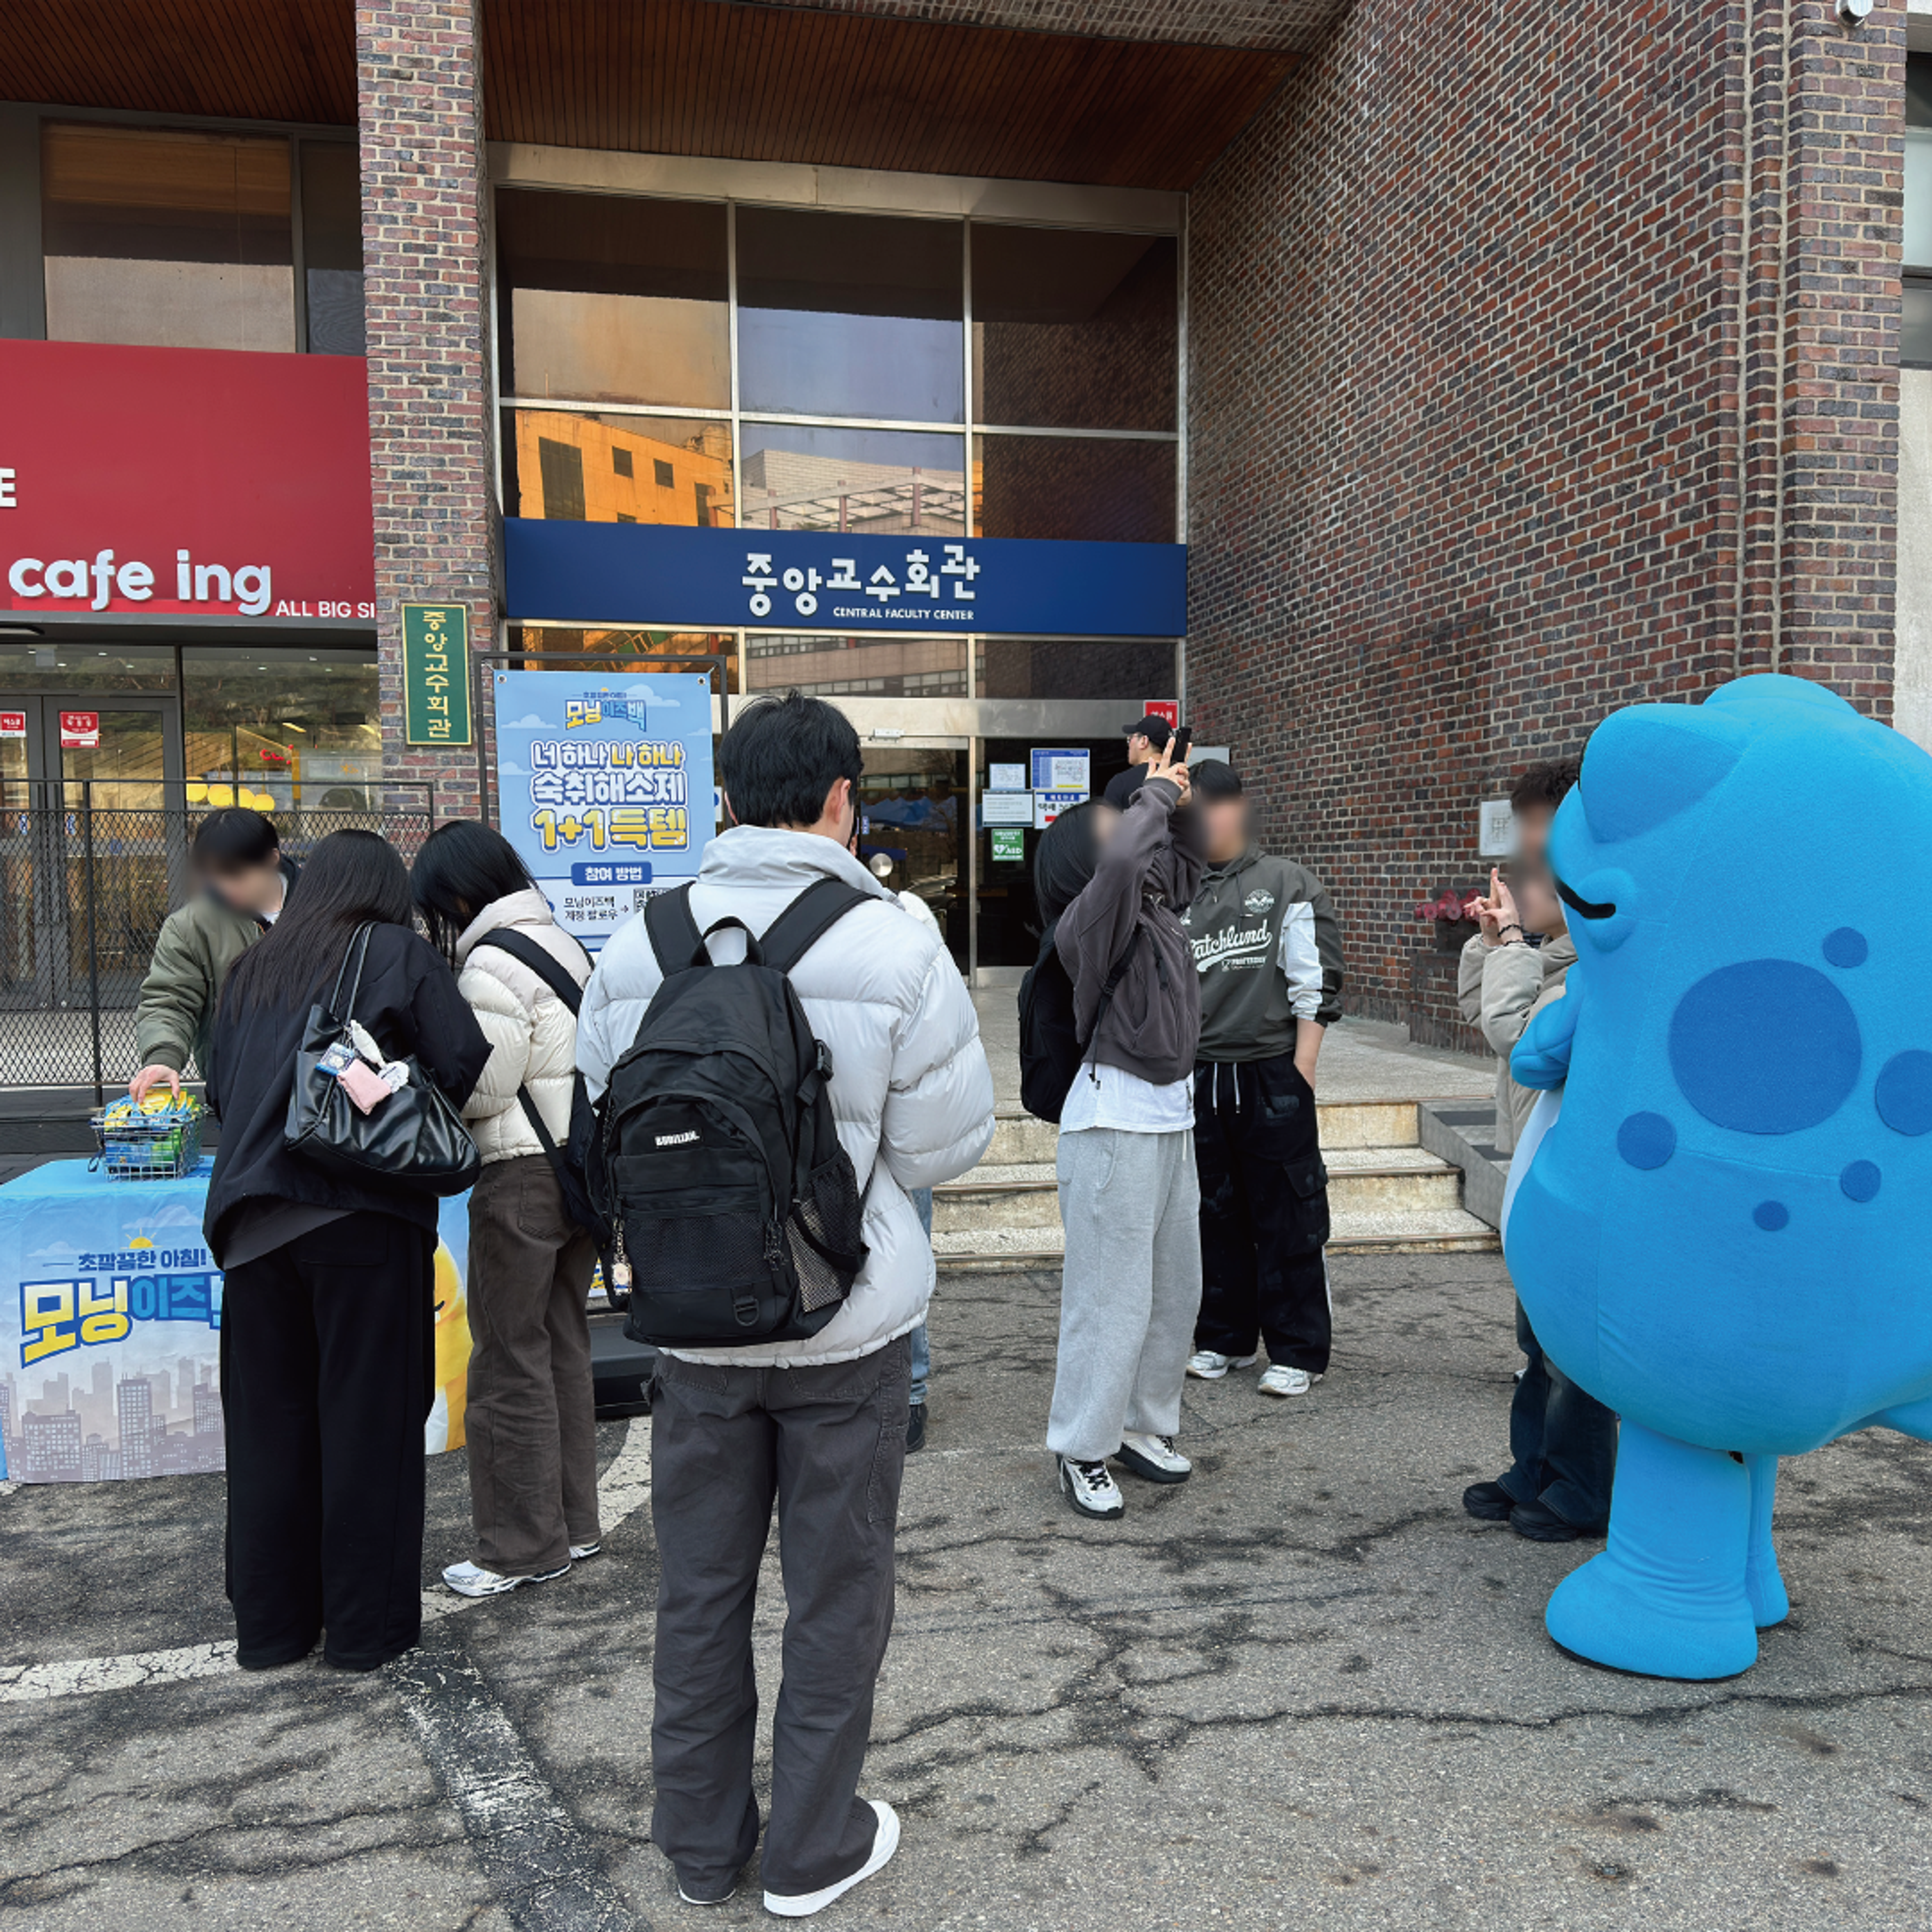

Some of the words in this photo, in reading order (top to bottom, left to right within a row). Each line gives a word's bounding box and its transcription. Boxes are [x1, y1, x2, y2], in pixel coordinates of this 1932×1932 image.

[0, 468, 17, 507] E
[9, 549, 154, 611] cafe
[177, 549, 271, 616] ing
[742, 544, 981, 617] 중앙교수회관
[275, 600, 313, 617] ALL
[318, 601, 352, 618] BIG
[833, 607, 882, 618] CENTRAL
[885, 608, 931, 619] FACULTY
[933, 610, 974, 620] CENTER
[423, 611, 452, 738] 중앙교수회관
[566, 699, 647, 732] 모닝이즈백
[534, 742, 557, 769] 너
[560, 742, 607, 769] 하나
[610, 742, 634, 769] 나
[637, 742, 683, 769] 하나
[533, 772, 686, 805] 숙취해소제
[533, 808, 606, 850] 1+1
[609, 807, 688, 850] 득템
[585, 866, 613, 881] 참여
[615, 866, 642, 881] 방법
[564, 896, 615, 908] 모닝이즈백
[588, 909, 618, 921] 팔로우
[78, 1250, 156, 1272] 초깔끔한
[160, 1248, 207, 1268] 아침!
